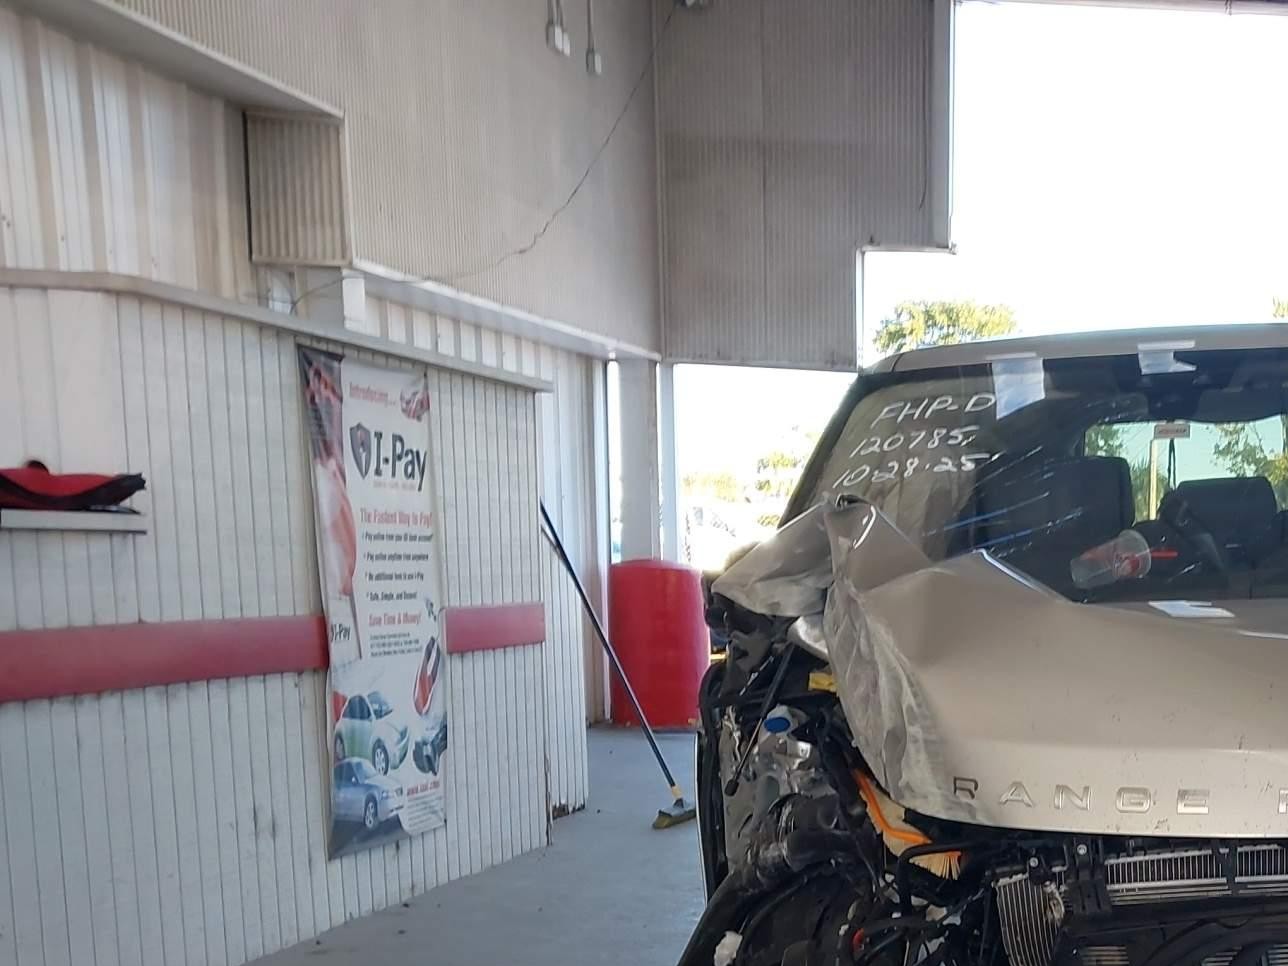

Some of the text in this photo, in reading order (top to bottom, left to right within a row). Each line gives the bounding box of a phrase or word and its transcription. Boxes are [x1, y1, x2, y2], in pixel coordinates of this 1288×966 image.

[373, 430, 427, 492] I-Pay
[360, 508, 372, 524] The
[953, 776, 1210, 815] RANGE
